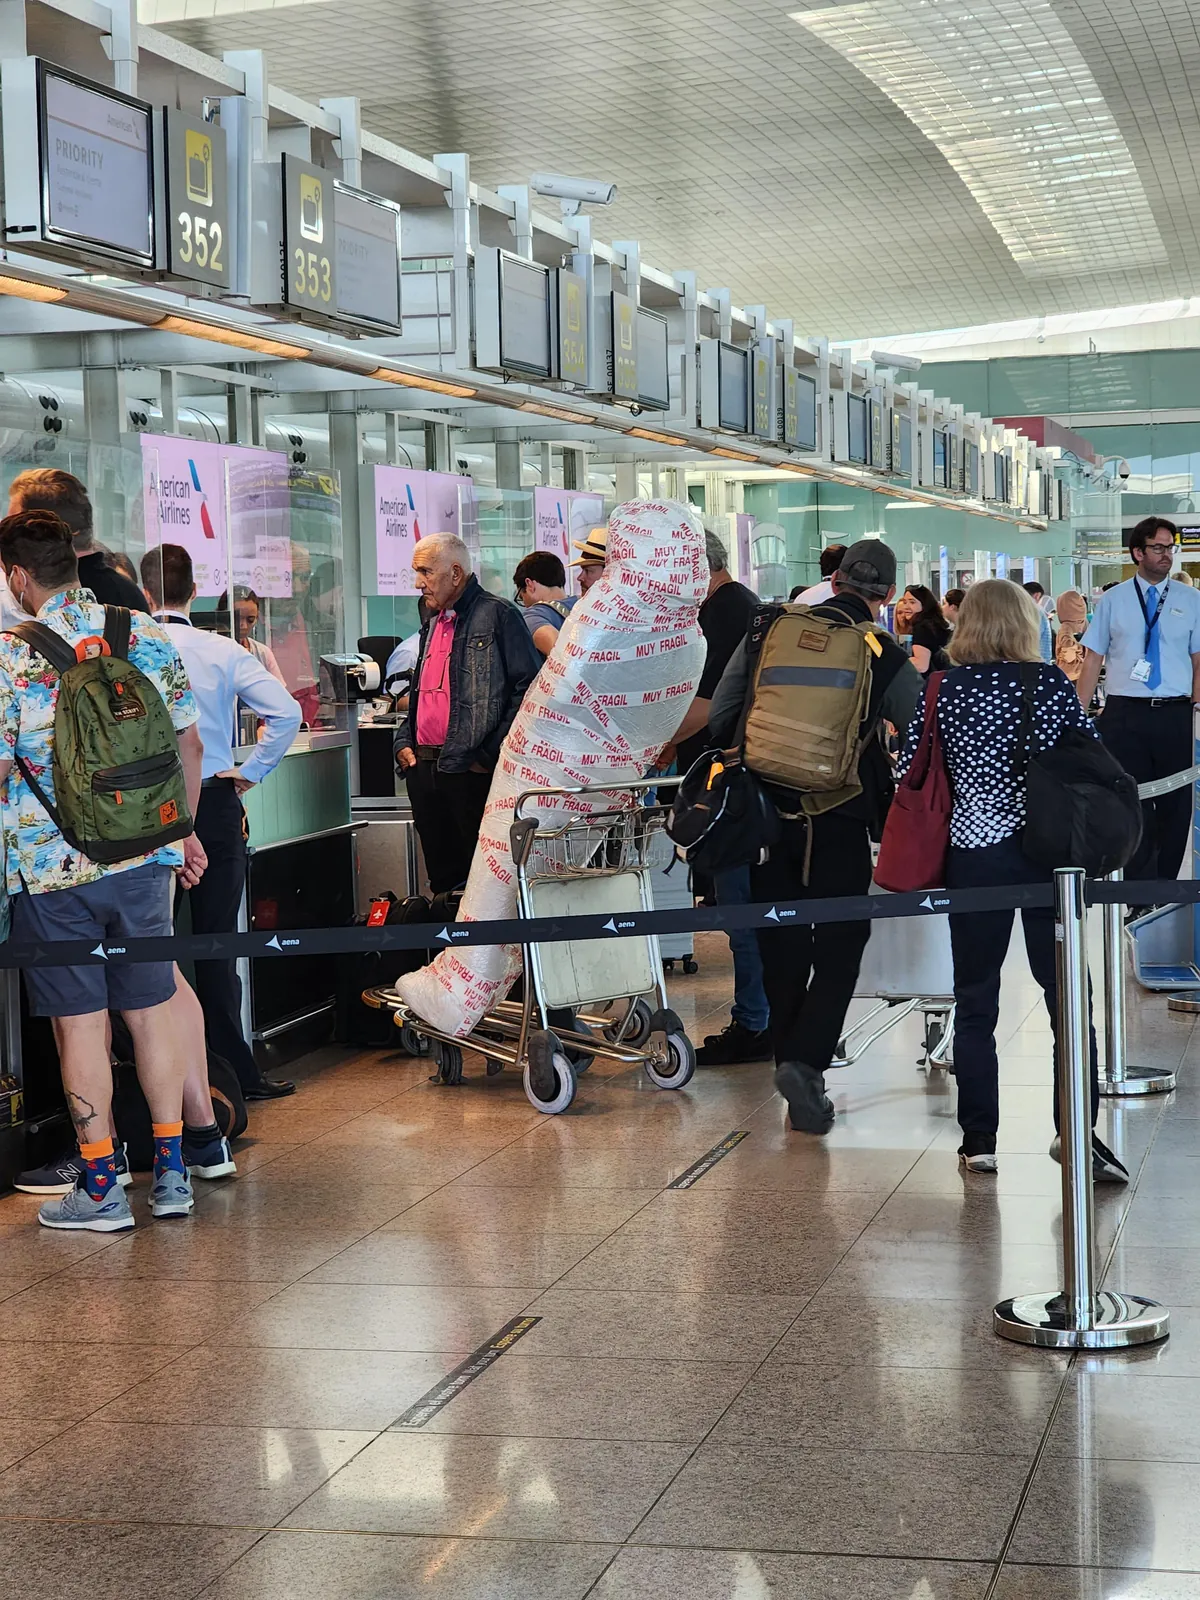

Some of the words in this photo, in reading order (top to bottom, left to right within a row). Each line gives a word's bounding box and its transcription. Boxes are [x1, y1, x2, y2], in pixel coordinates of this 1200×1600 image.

[56, 138, 104, 169] PRIORITY
[178, 212, 222, 272] 352
[338, 238, 368, 260] PRIORITY
[295, 248, 331, 302] 353
[778, 432, 784, 440] SE
[159, 500, 190, 525] Airlines
[380, 496, 407, 516] American
[385, 518, 407, 537] Airlines
[538, 512, 558, 529] American
[542, 530, 558, 546] Airlines
[655, 546, 677, 558] MUY
[679, 522, 696, 542] MUY
[691, 548, 701, 584] FRAGIL
[646, 558, 668, 568] MUY
[620, 572, 644, 588] MUY
[647, 580, 681, 596] FRAGIL
[670, 574, 689, 585] MUY
[636, 590, 656, 605] MUY
[653, 614, 674, 625] MUY
[565, 642, 586, 659] MUY
[588, 651, 621, 662] FRAGIL
[636, 644, 656, 658] MUY
[660, 634, 688, 653] FRAGIL
[598, 694, 628, 706] FRAGIL
[642, 690, 662, 704] MUY
[665, 681, 693, 698] FRAGIL
[576, 681, 592, 701] MUY
[588, 699, 610, 728] FRAGIL
[538, 707, 570, 724] FRAGIL
[531, 744, 565, 764] FRAGIL
[581, 755, 602, 765] MUY
[503, 759, 517, 776] MUY
[520, 767, 551, 787] FRAGIL
[538, 796, 559, 808] MUY
[562, 800, 593, 812] FRAGIL
[486, 855, 513, 885] FRAGIL
[448, 956, 475, 982] FRAGIL
